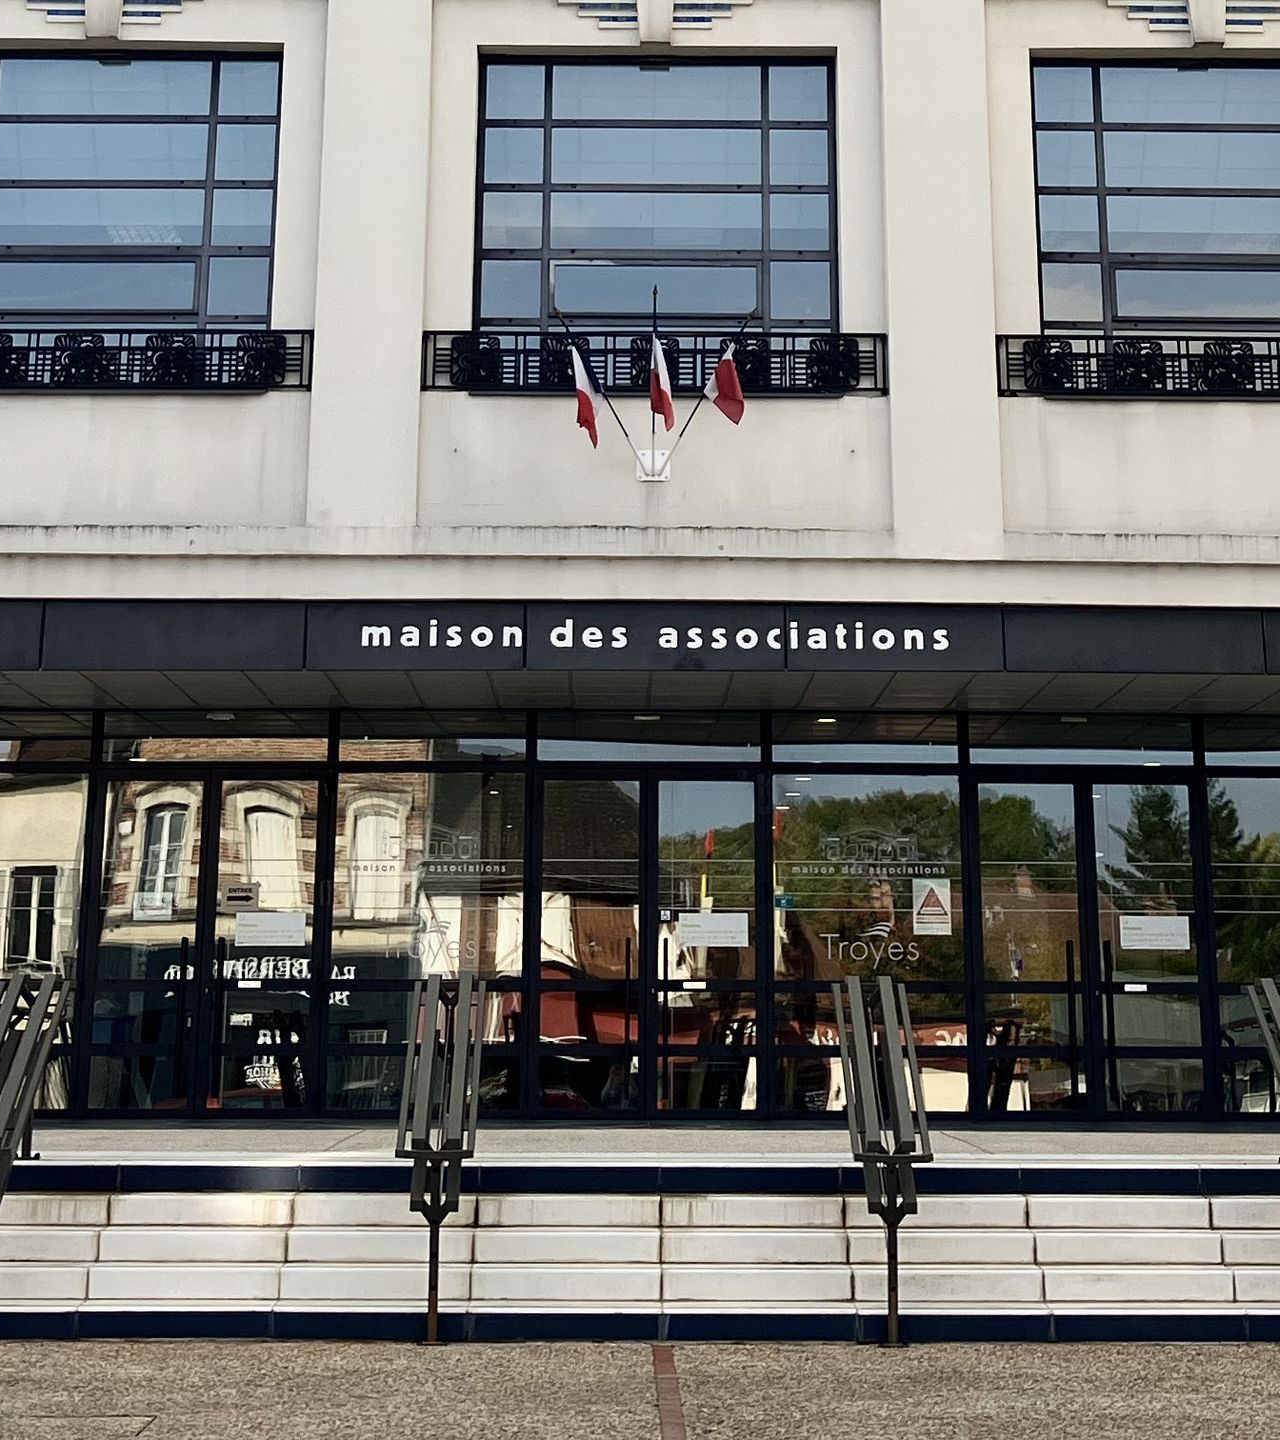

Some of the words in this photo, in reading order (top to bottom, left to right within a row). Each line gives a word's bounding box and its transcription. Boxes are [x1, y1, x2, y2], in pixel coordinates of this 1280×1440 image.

[361, 619, 524, 648] maison
[549, 618, 628, 649] des
[658, 619, 951, 651] associations
[429, 863, 507, 872] associations
[792, 865, 835, 874] maison
[841, 865, 863, 874] des
[869, 865, 946, 874] associations
[820, 934, 920, 970] Troyes
